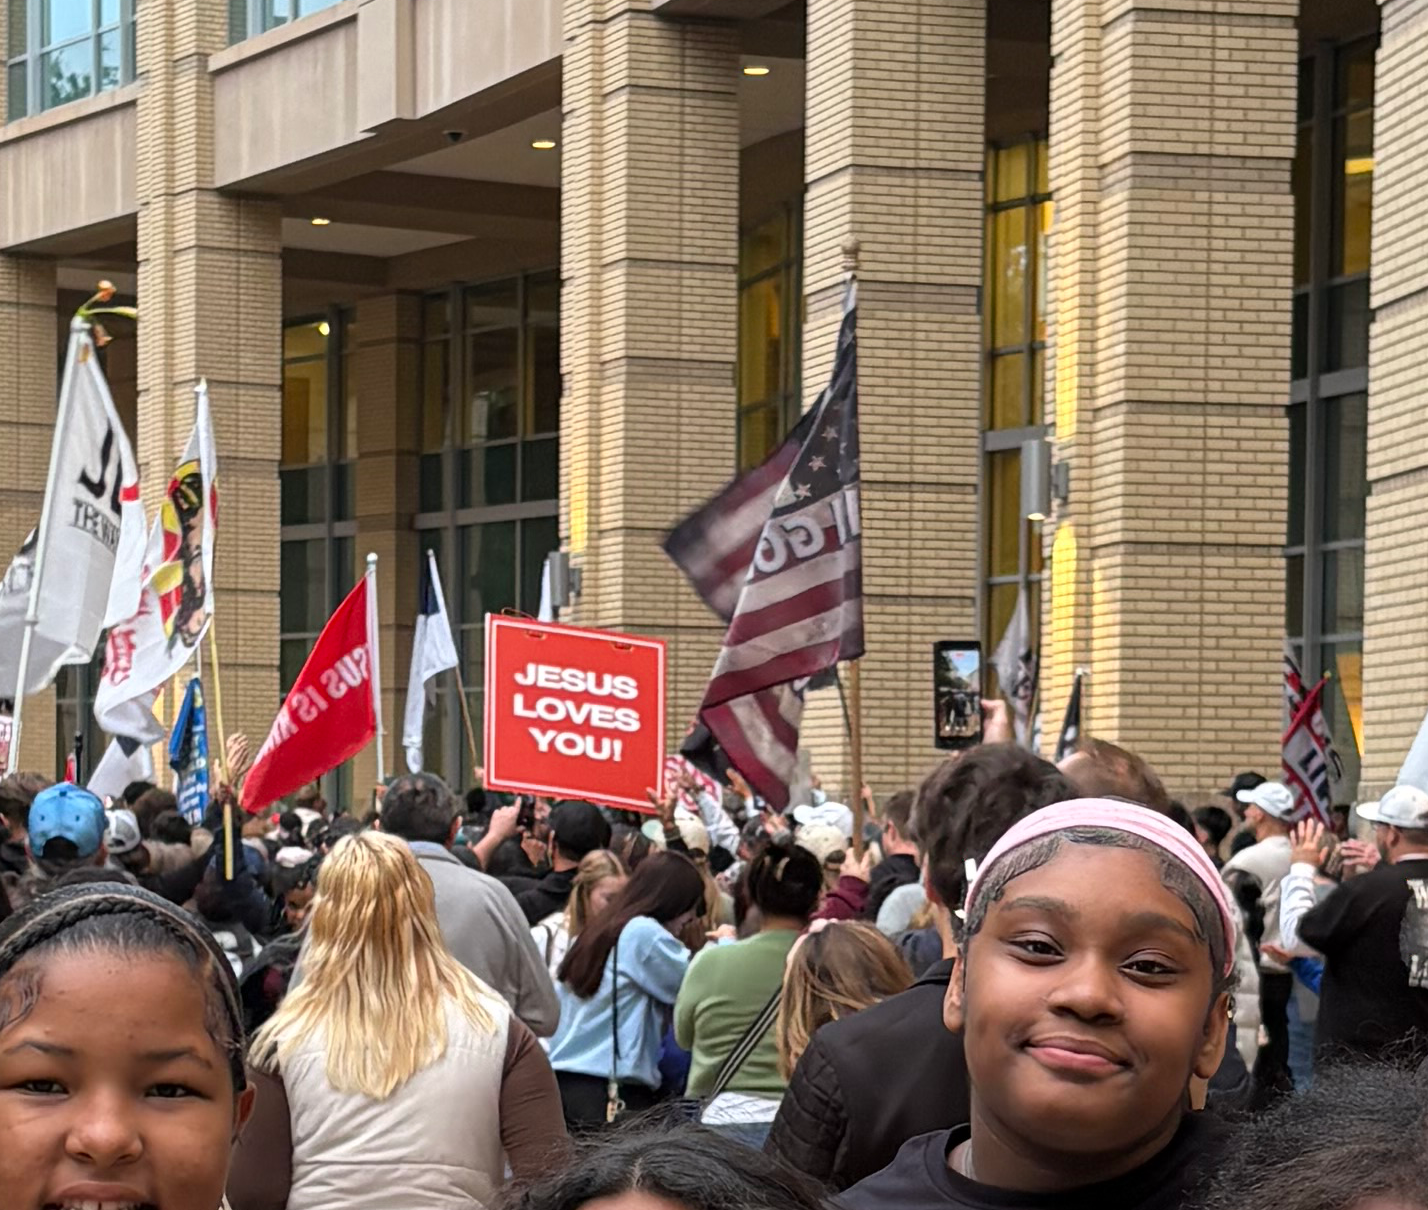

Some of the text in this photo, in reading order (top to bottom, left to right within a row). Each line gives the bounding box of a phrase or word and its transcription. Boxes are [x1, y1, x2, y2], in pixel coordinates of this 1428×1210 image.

[514, 662, 639, 700] JESUS
[513, 693, 641, 732] LOVES
[528, 726, 623, 762] YOU!
